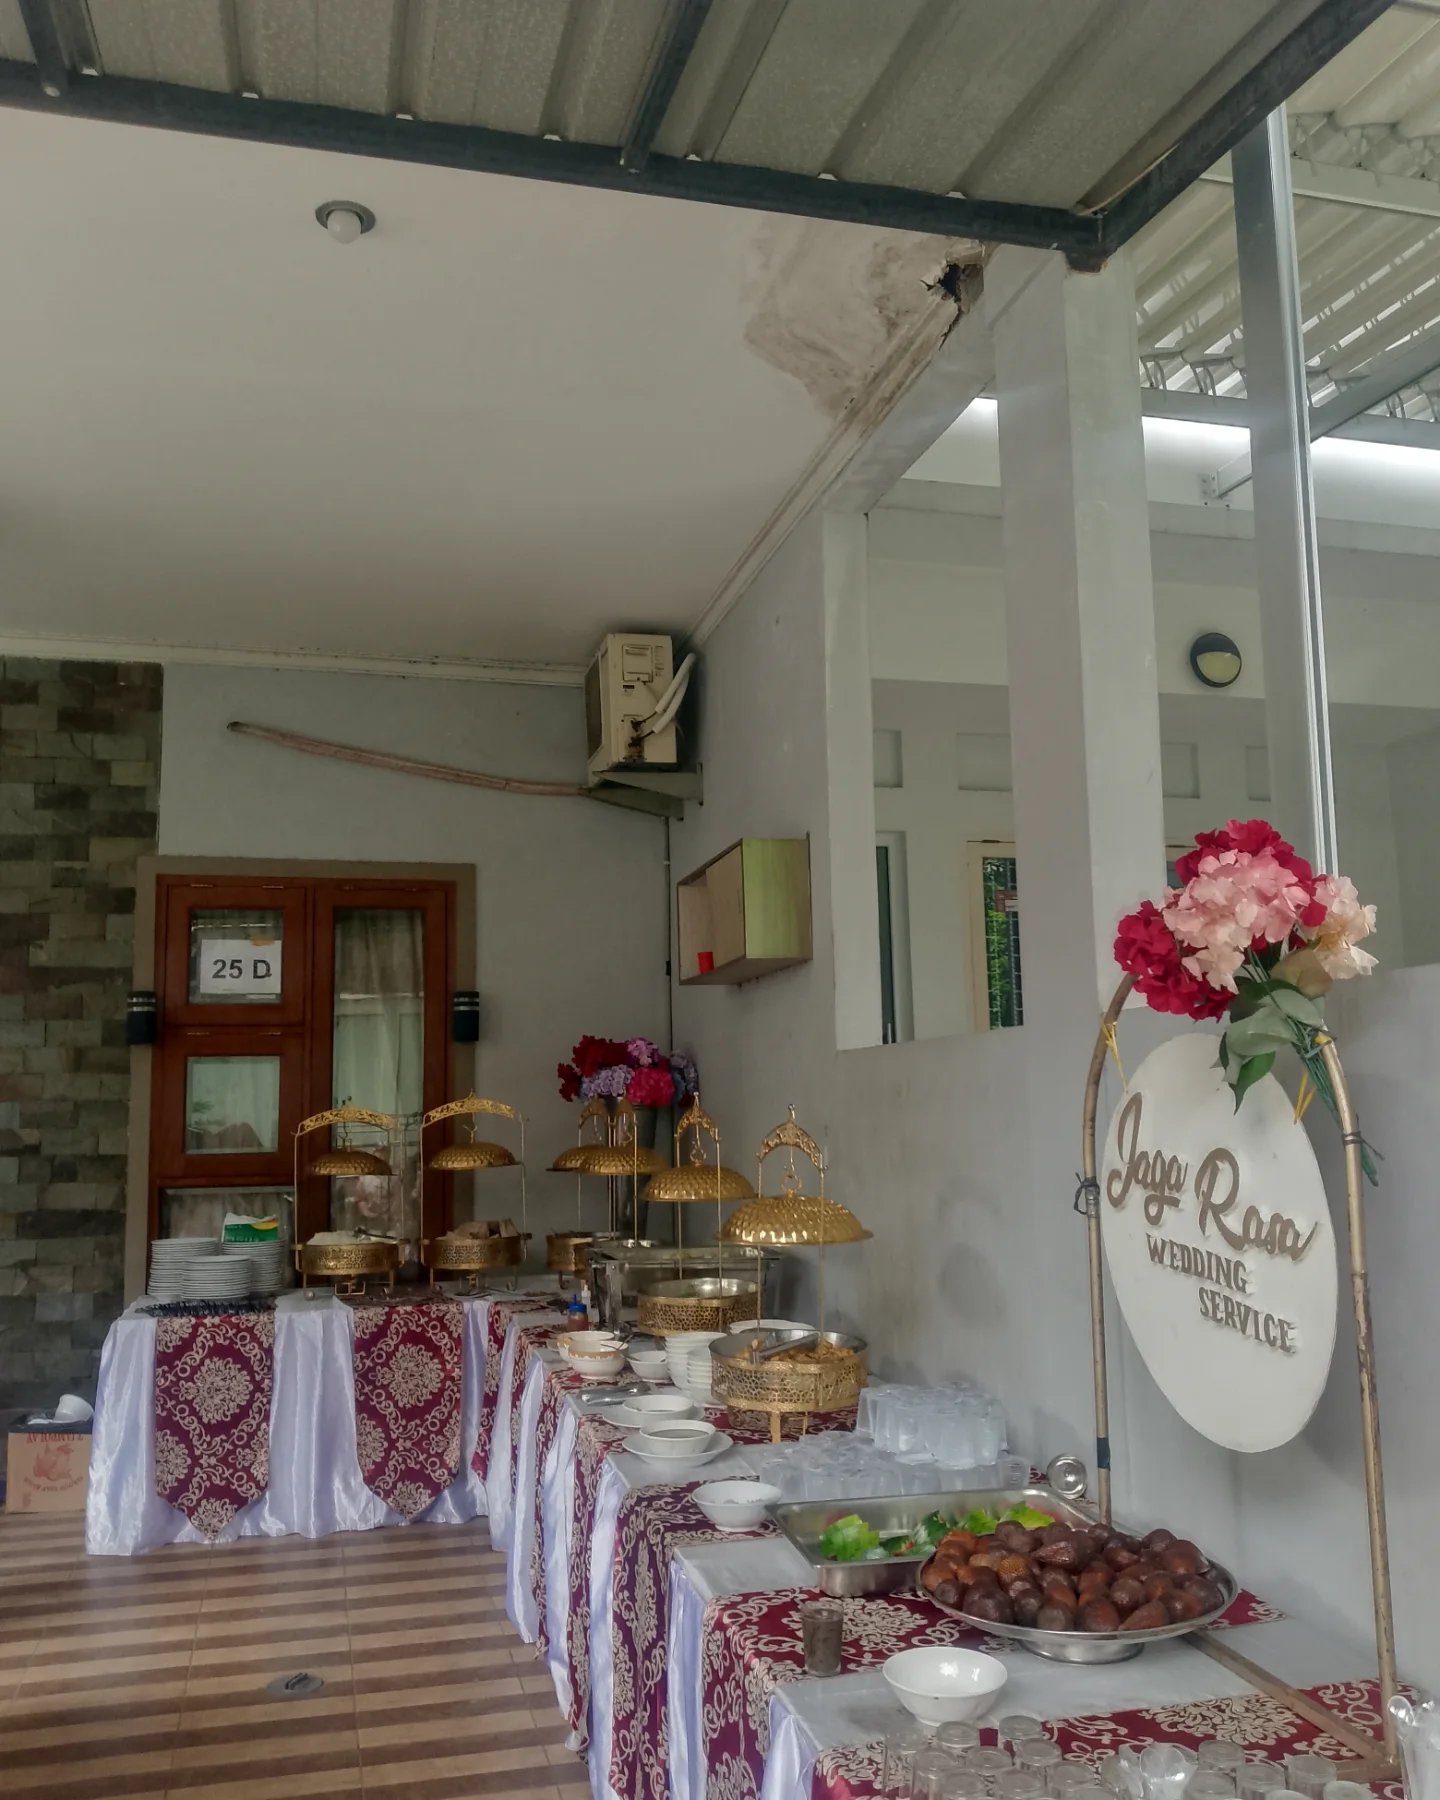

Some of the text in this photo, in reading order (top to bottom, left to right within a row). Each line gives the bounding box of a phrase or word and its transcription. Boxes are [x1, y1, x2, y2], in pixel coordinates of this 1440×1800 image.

[212, 959, 272, 979] 25 D
[1107, 1092, 1317, 1261] Jaga Rasa
[1146, 1233, 1248, 1293] WEDDING
[1199, 1287, 1296, 1353] SERVICE
